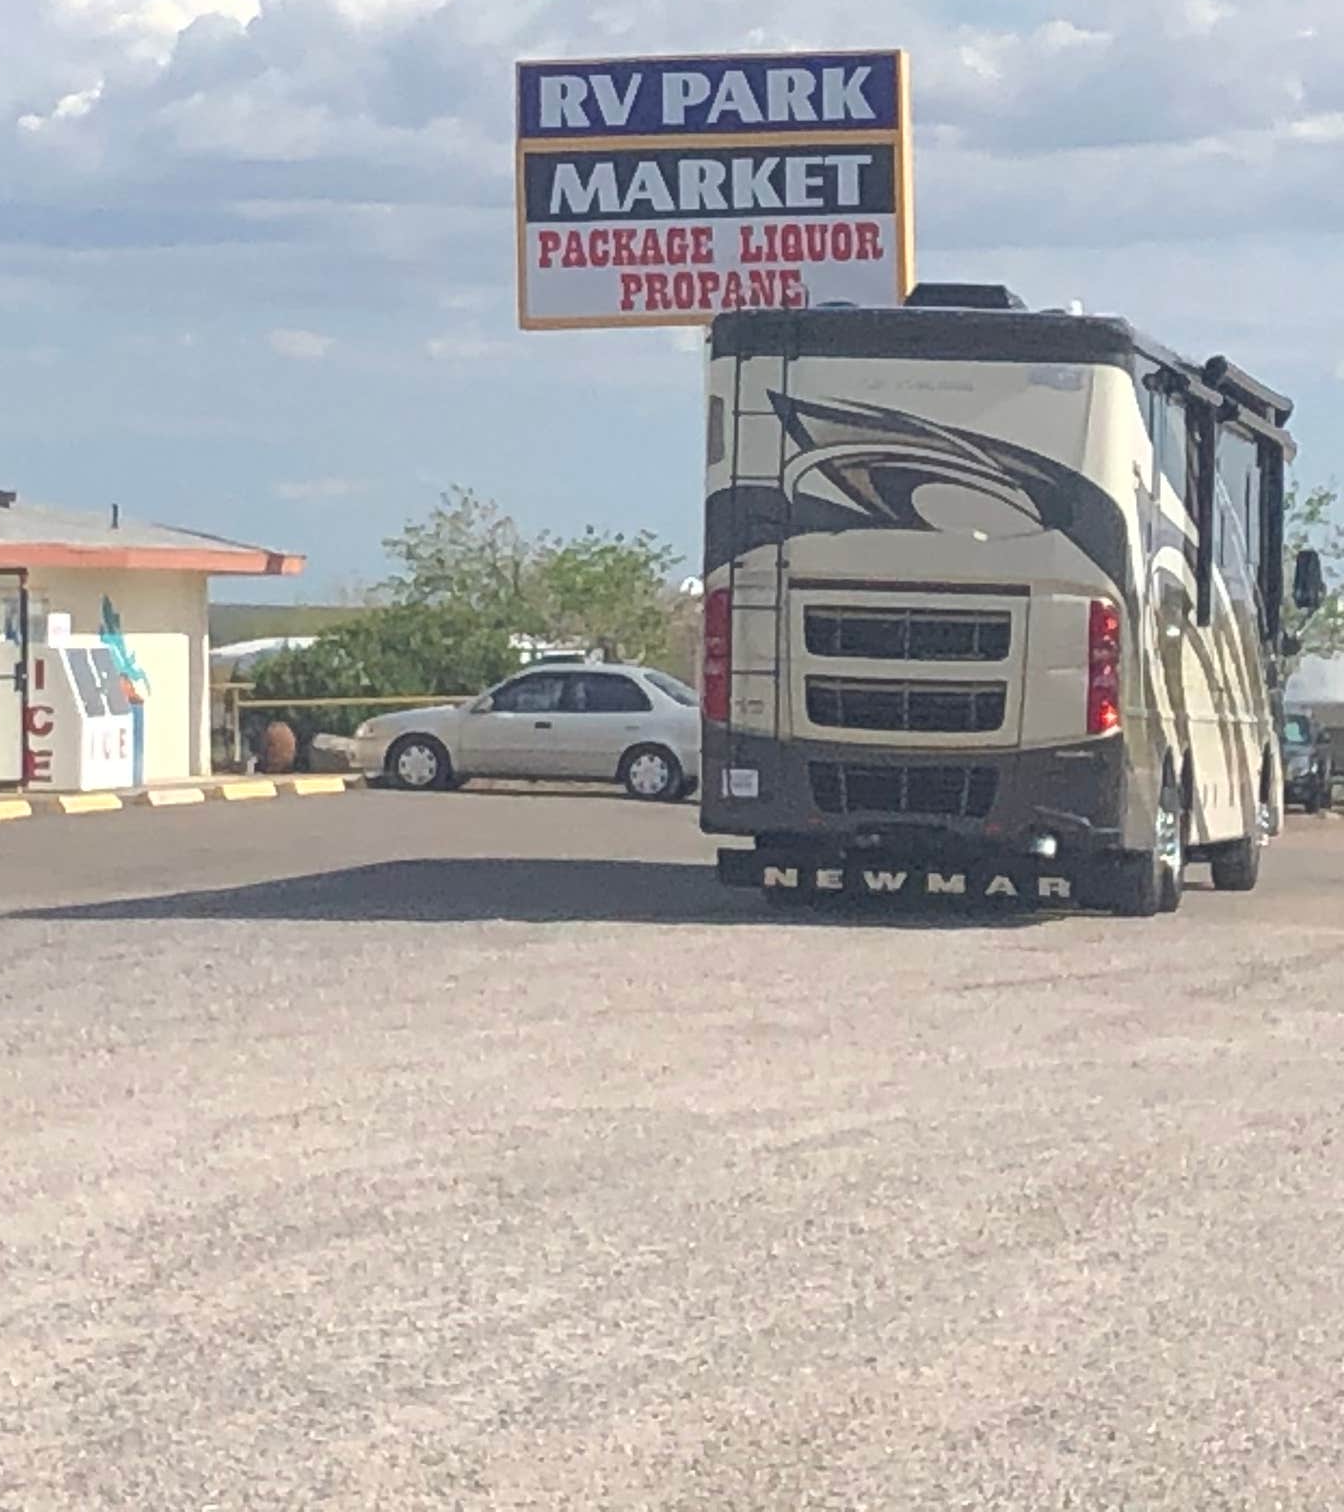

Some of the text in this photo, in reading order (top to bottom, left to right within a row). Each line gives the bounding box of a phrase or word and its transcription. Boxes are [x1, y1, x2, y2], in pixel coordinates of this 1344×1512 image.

[539, 66, 876, 128] RV PARK
[550, 154, 872, 214] MARKET
[538, 222, 883, 268] PACKAGE LIQUOR
[620, 269, 803, 311] PROPANE
[26, 659, 54, 782] ICE
[764, 867, 1071, 897] NEWMAR
